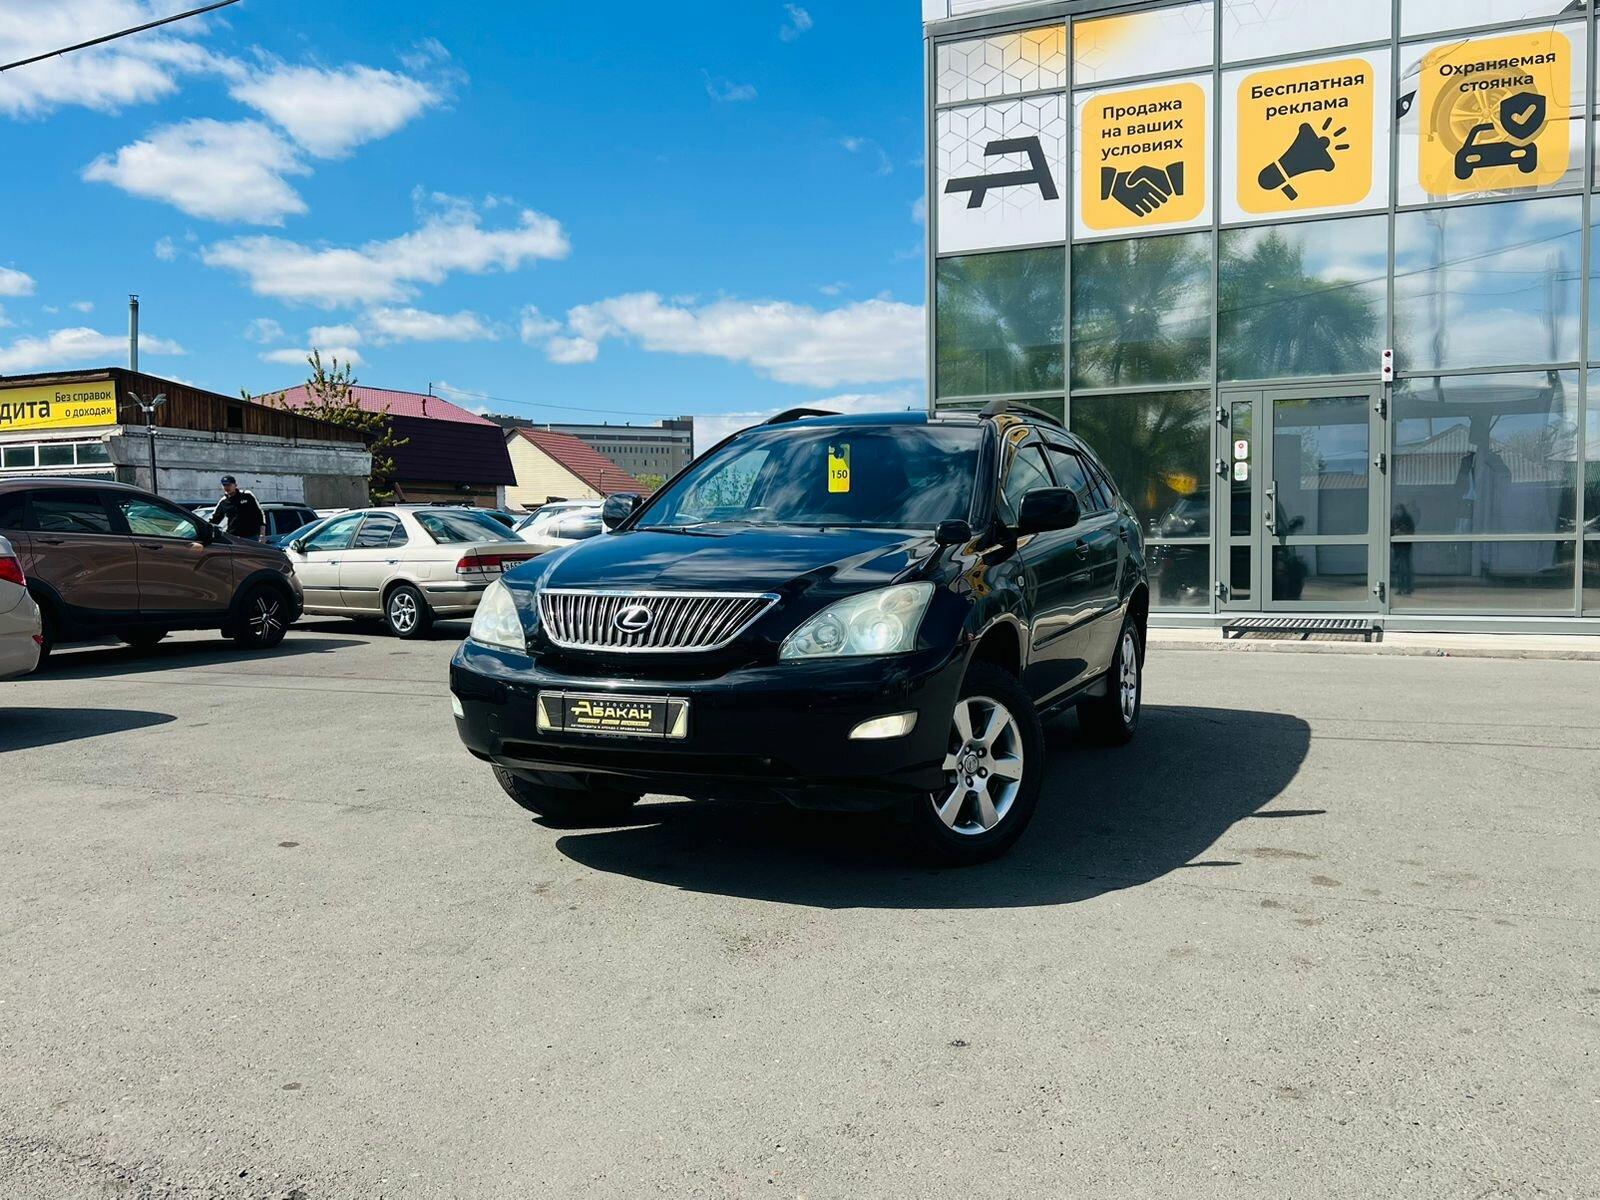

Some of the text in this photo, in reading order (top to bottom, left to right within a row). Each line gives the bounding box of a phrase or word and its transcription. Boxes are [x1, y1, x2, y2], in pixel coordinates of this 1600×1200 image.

[1439, 52, 1556, 77] Охраняемая
[1251, 74, 1365, 100] Бесплатная
[1459, 74, 1534, 93] стоянка
[1103, 99, 1182, 120] Продажа
[1266, 96, 1349, 120] реклама
[1101, 118, 1183, 139] на ваших
[1101, 138, 1183, 161] условиях
[55, 391, 112, 402] Без справок
[65, 407, 112, 418] о доходах
[832, 469, 848, 479] 150
